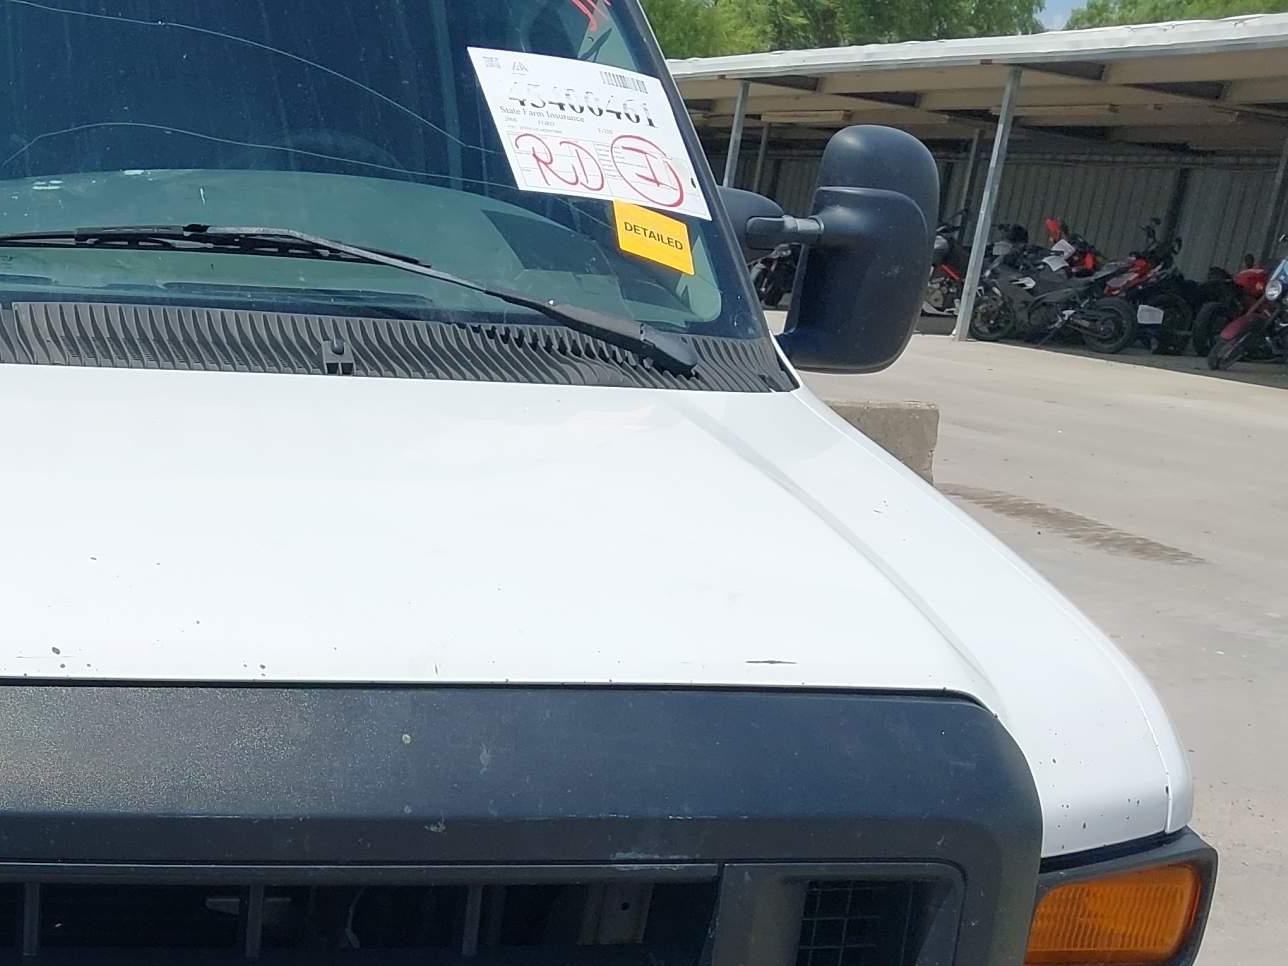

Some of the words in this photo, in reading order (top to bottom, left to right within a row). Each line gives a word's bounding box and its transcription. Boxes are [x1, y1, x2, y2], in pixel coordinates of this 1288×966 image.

[500, 105, 521, 115] State
[523, 108, 545, 118] Farm
[624, 221, 683, 250] DETAILED
